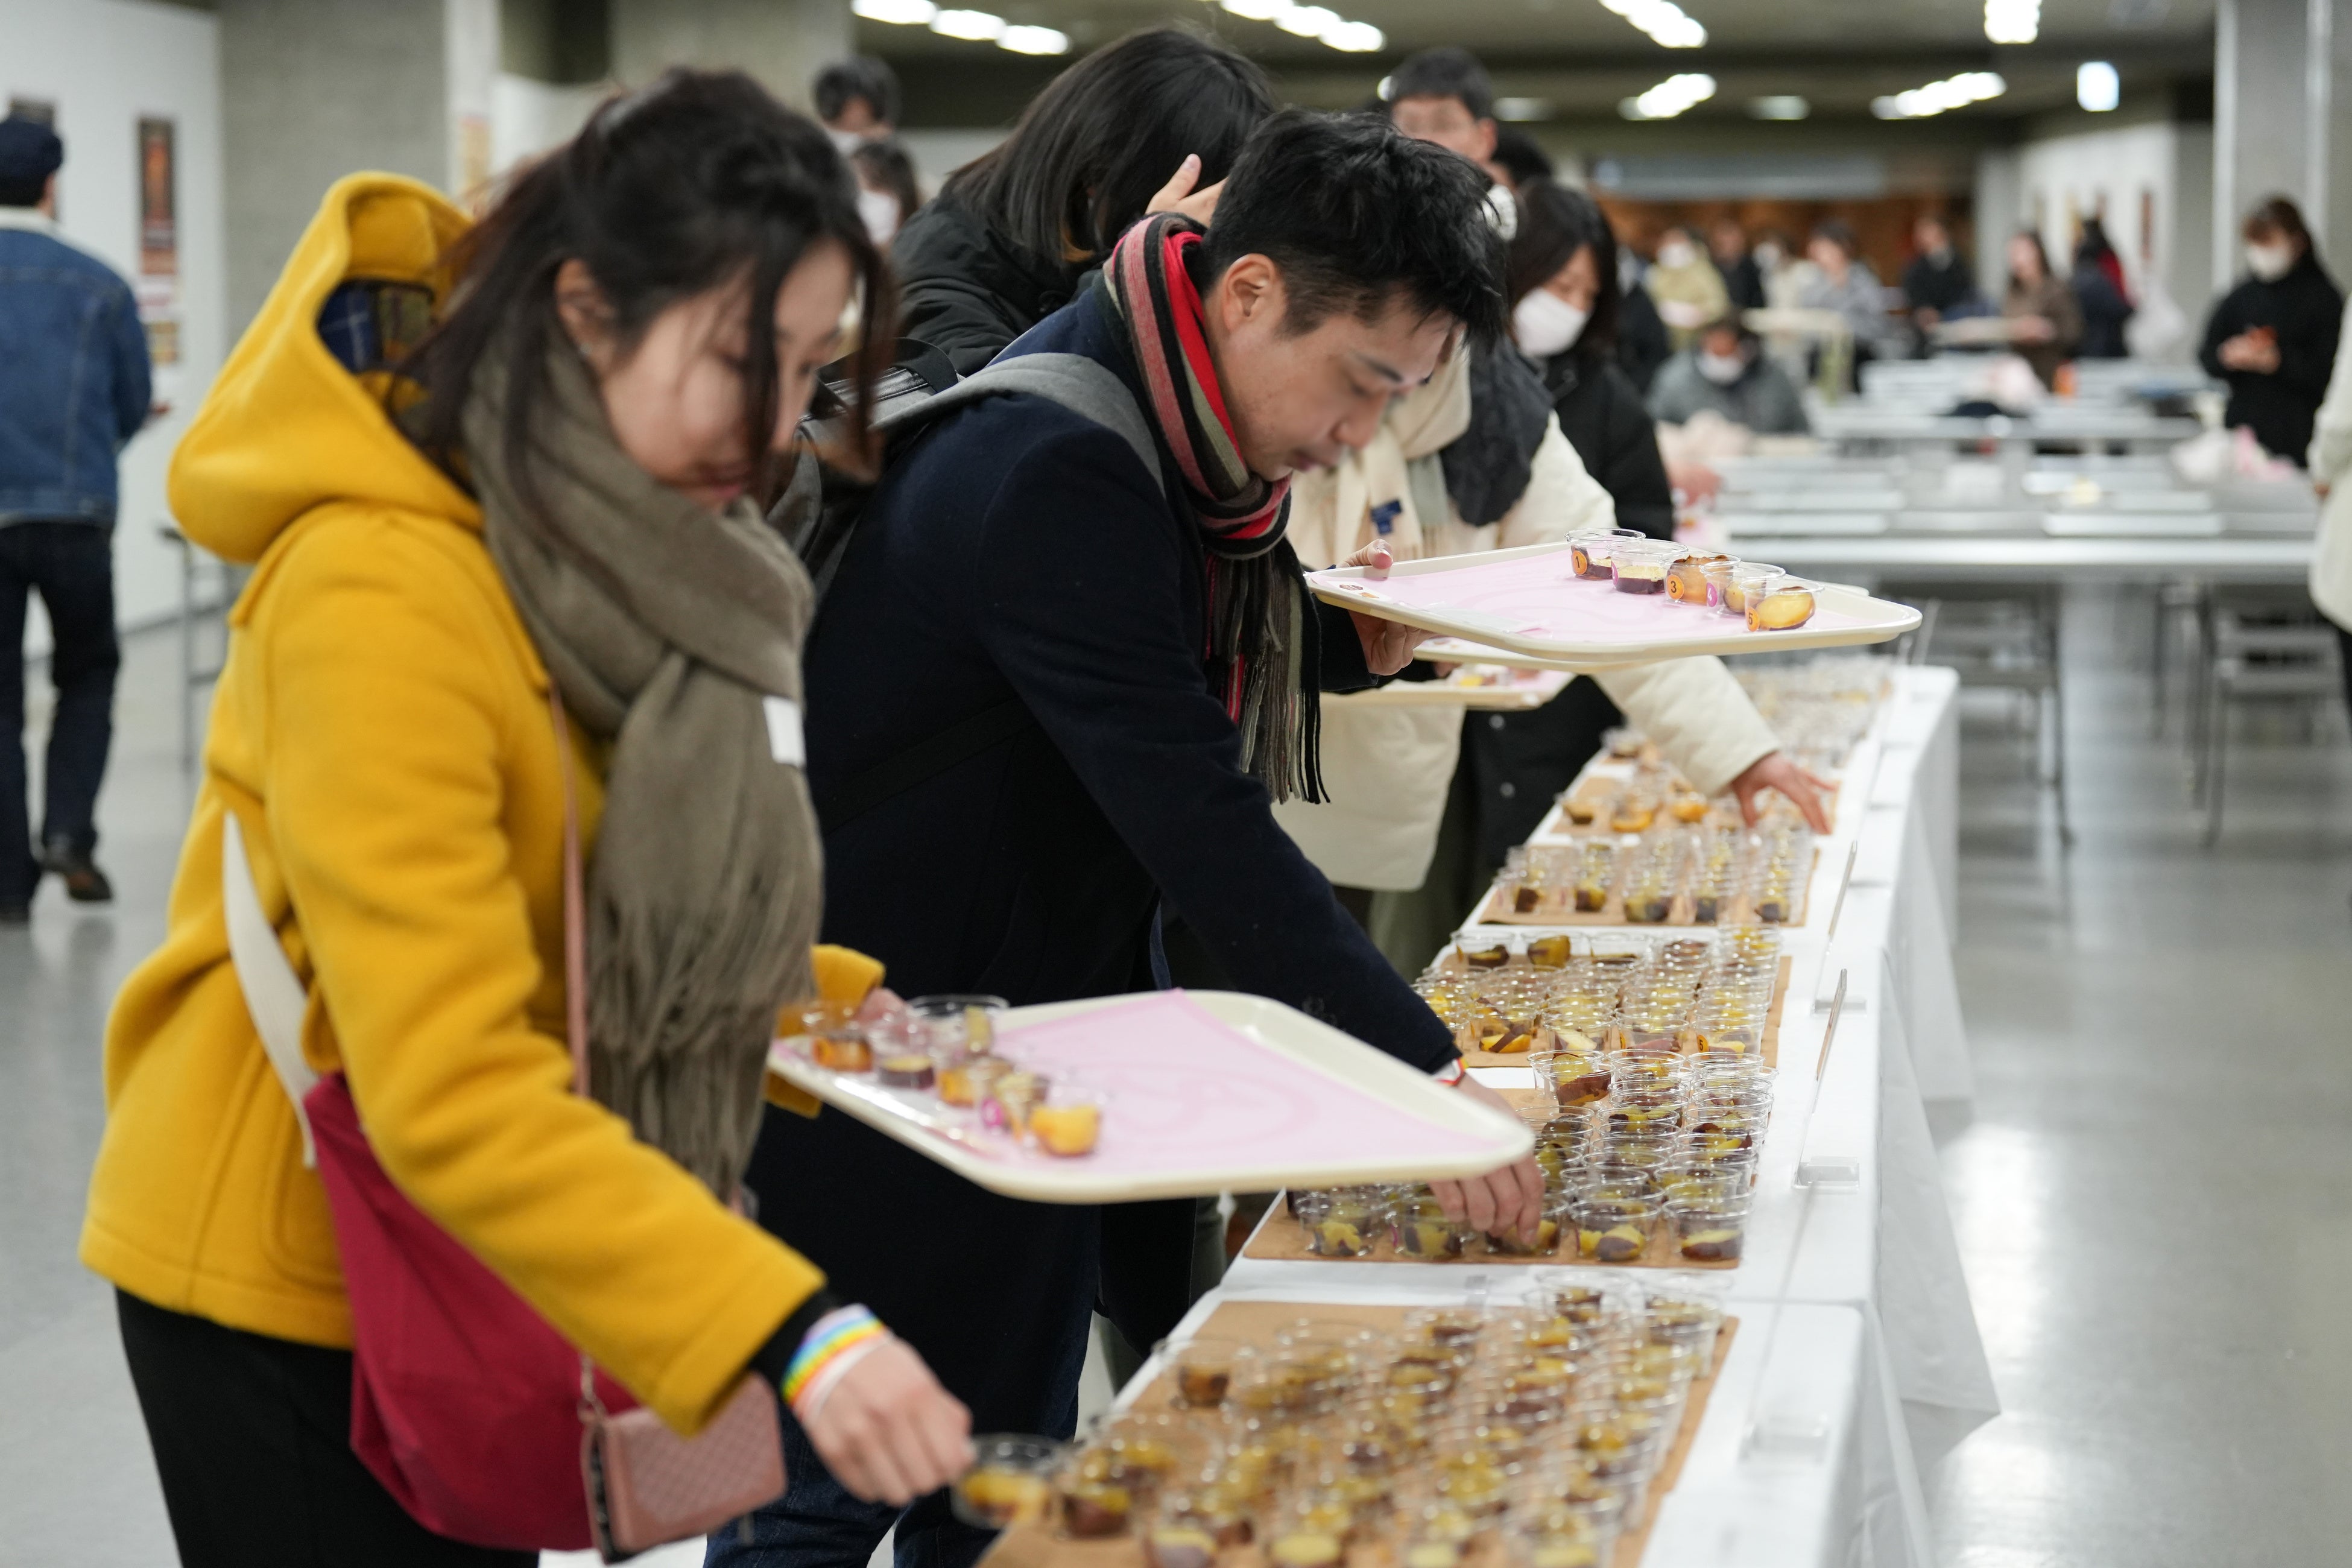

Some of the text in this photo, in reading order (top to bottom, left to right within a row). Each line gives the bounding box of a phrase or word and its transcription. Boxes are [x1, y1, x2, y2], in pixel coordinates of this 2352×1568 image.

[1575, 555, 1580, 568] 1
[1670, 581, 1677, 593] 3
[1707, 587, 1712, 601] 4
[1749, 612, 1753, 625] 5
[1698, 1039, 1703, 1051] 5
